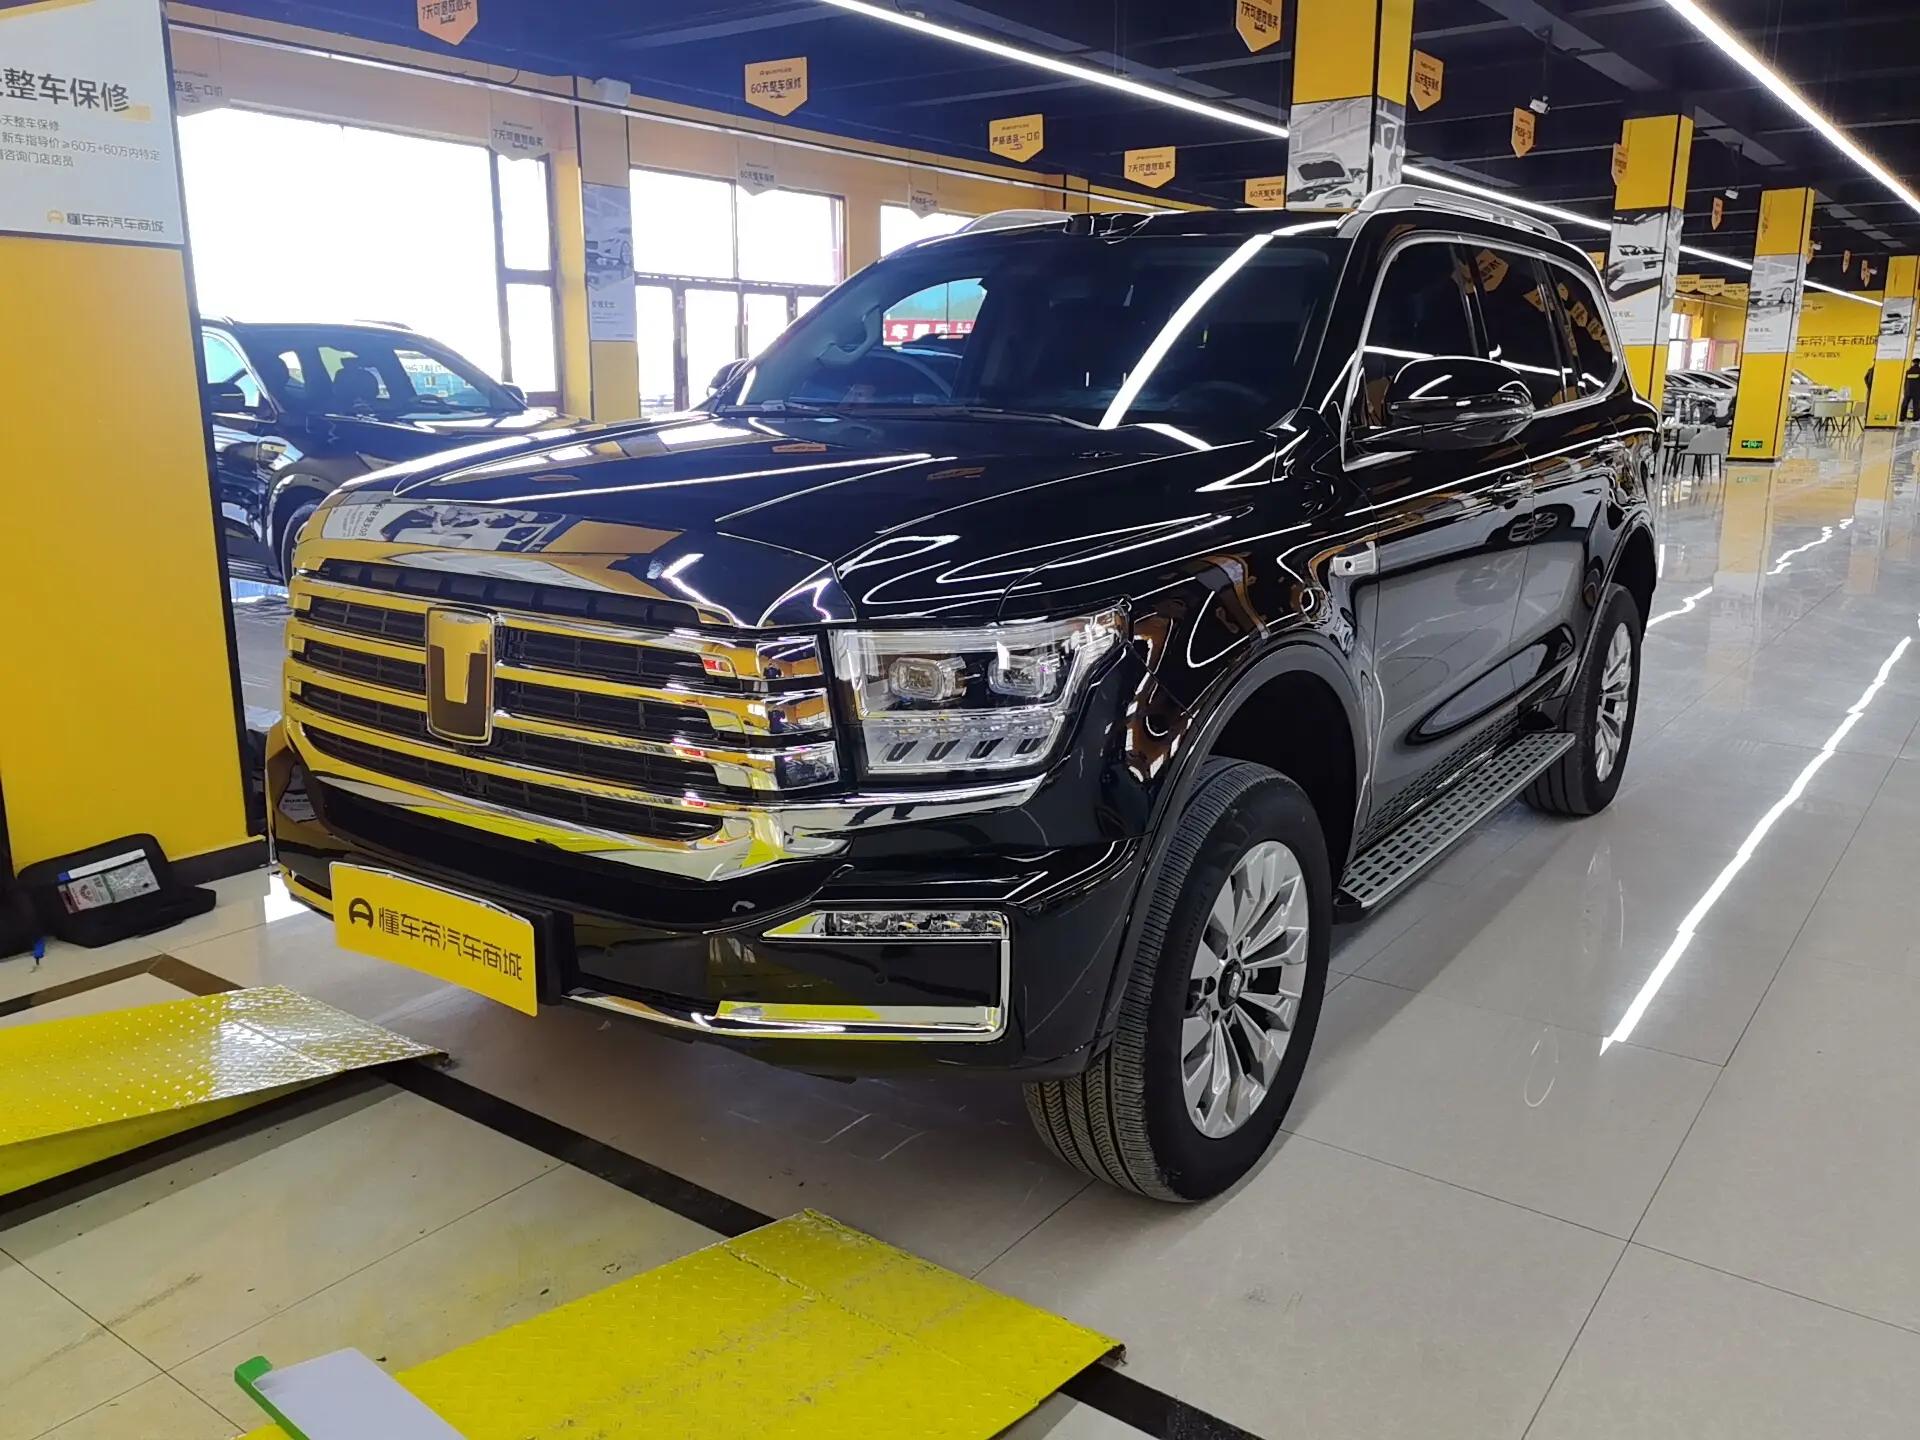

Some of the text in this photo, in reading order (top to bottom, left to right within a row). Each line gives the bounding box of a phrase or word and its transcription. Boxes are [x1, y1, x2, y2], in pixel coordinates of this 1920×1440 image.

[0, 67, 130, 112] 整车保修
[0, 114, 60, 131] 天整车保修
[378, 906, 524, 981] 懂车帝汽车商城
